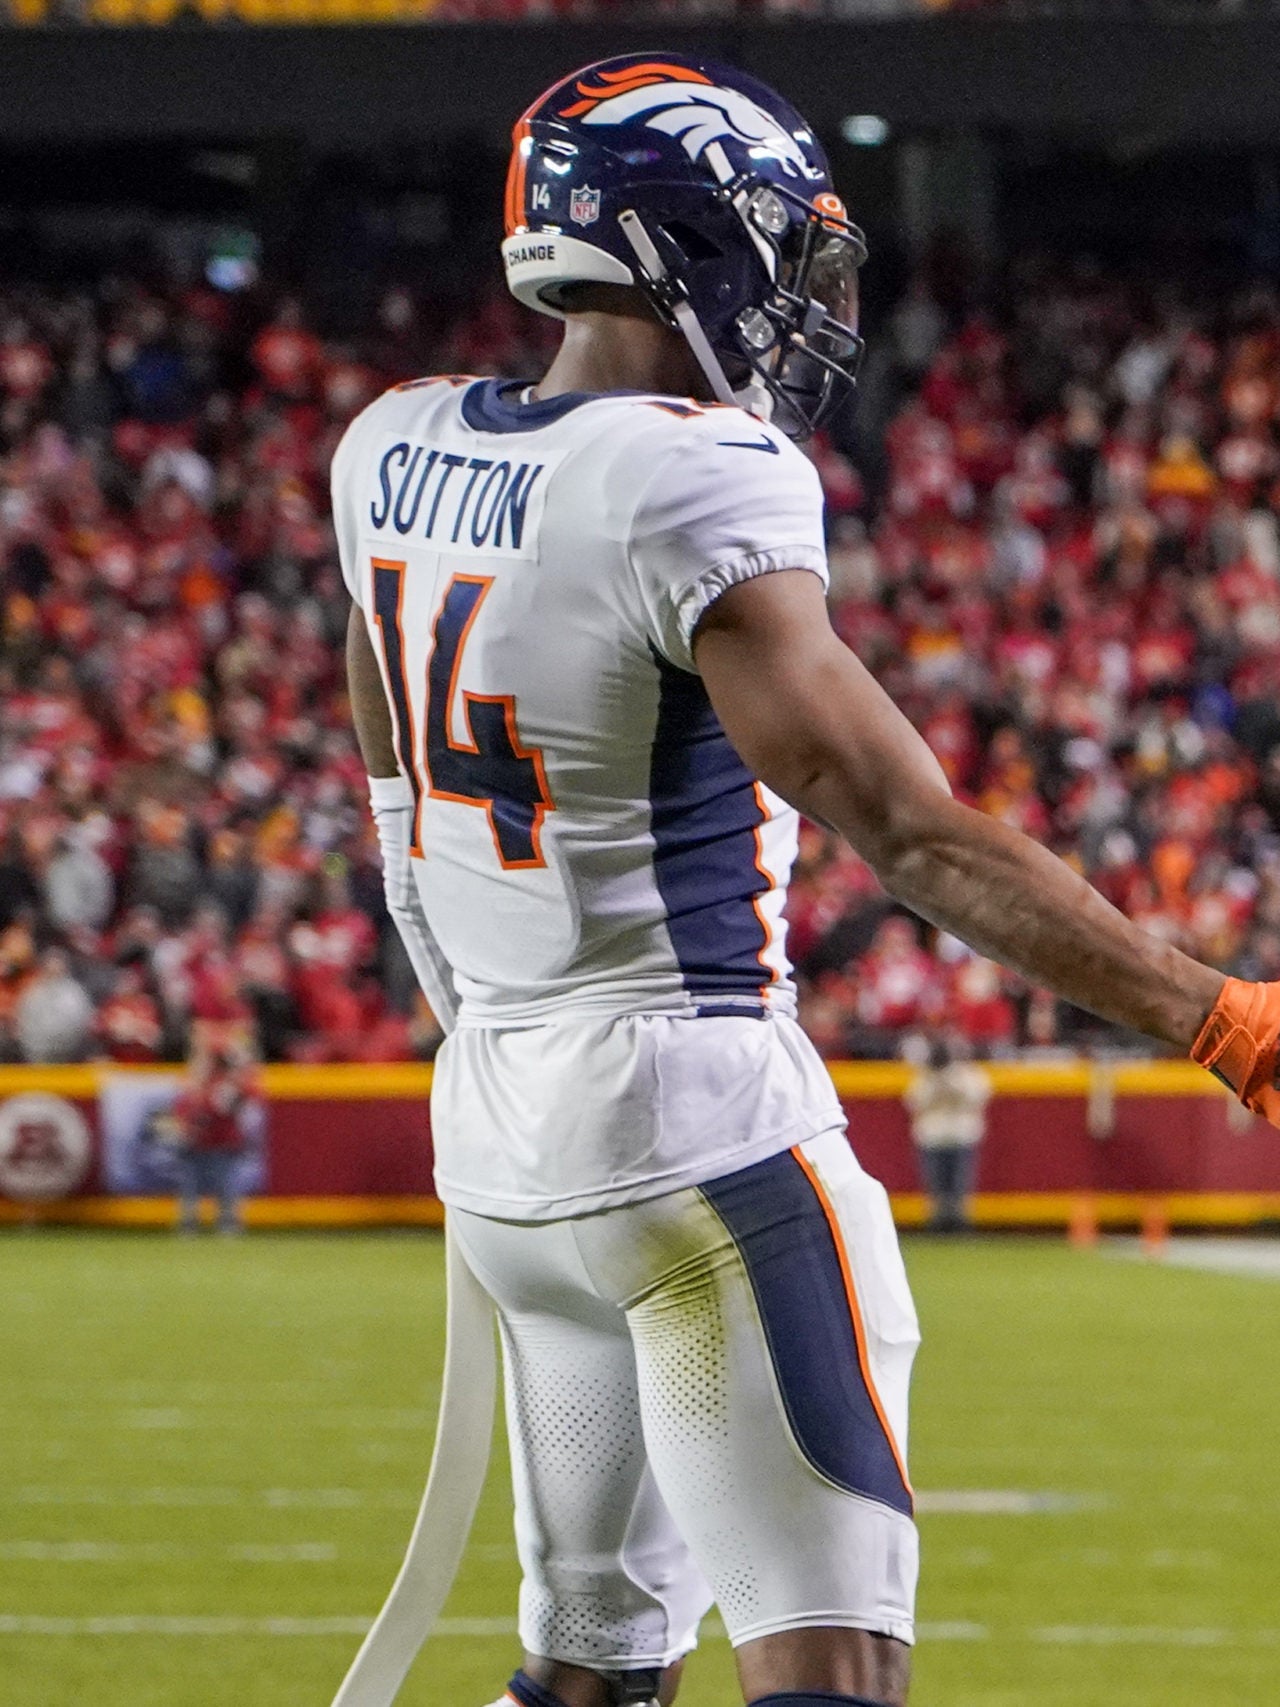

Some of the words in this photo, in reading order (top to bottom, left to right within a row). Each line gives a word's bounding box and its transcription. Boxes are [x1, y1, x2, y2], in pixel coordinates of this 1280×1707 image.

[531, 184, 551, 211] 14
[575, 203, 595, 218] NFL
[508, 245, 555, 266] CHANGE
[371, 442, 543, 550] SUTTON
[370, 556, 556, 870] 14
